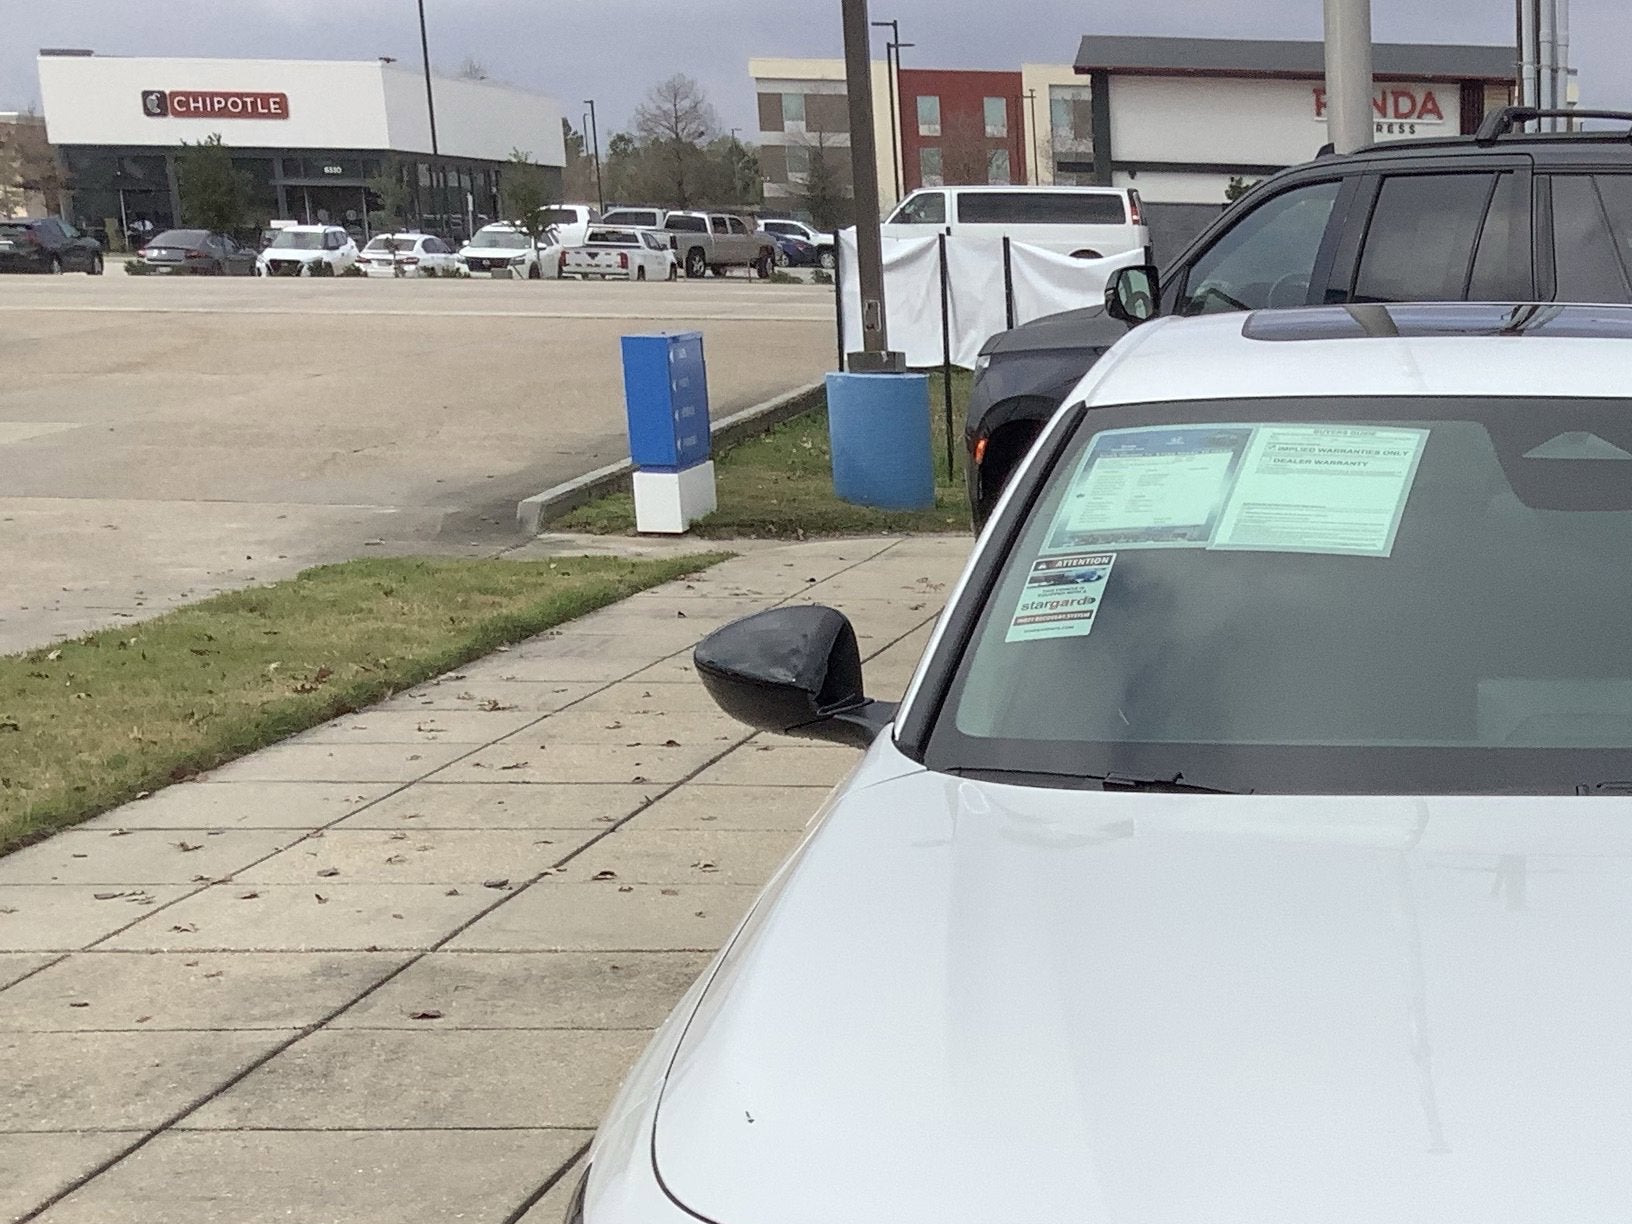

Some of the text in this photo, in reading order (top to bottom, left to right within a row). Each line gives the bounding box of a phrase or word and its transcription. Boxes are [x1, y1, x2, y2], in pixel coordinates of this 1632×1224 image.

[173, 96, 282, 113] CHIPOTLE
[1313, 86, 1444, 120] PNDA
[1318, 447, 1381, 456] WARRANTIES
[1382, 449, 1410, 457] ONLY
[1314, 459, 1369, 467] WARRANTY
[1055, 557, 1110, 568] ATTENTION
